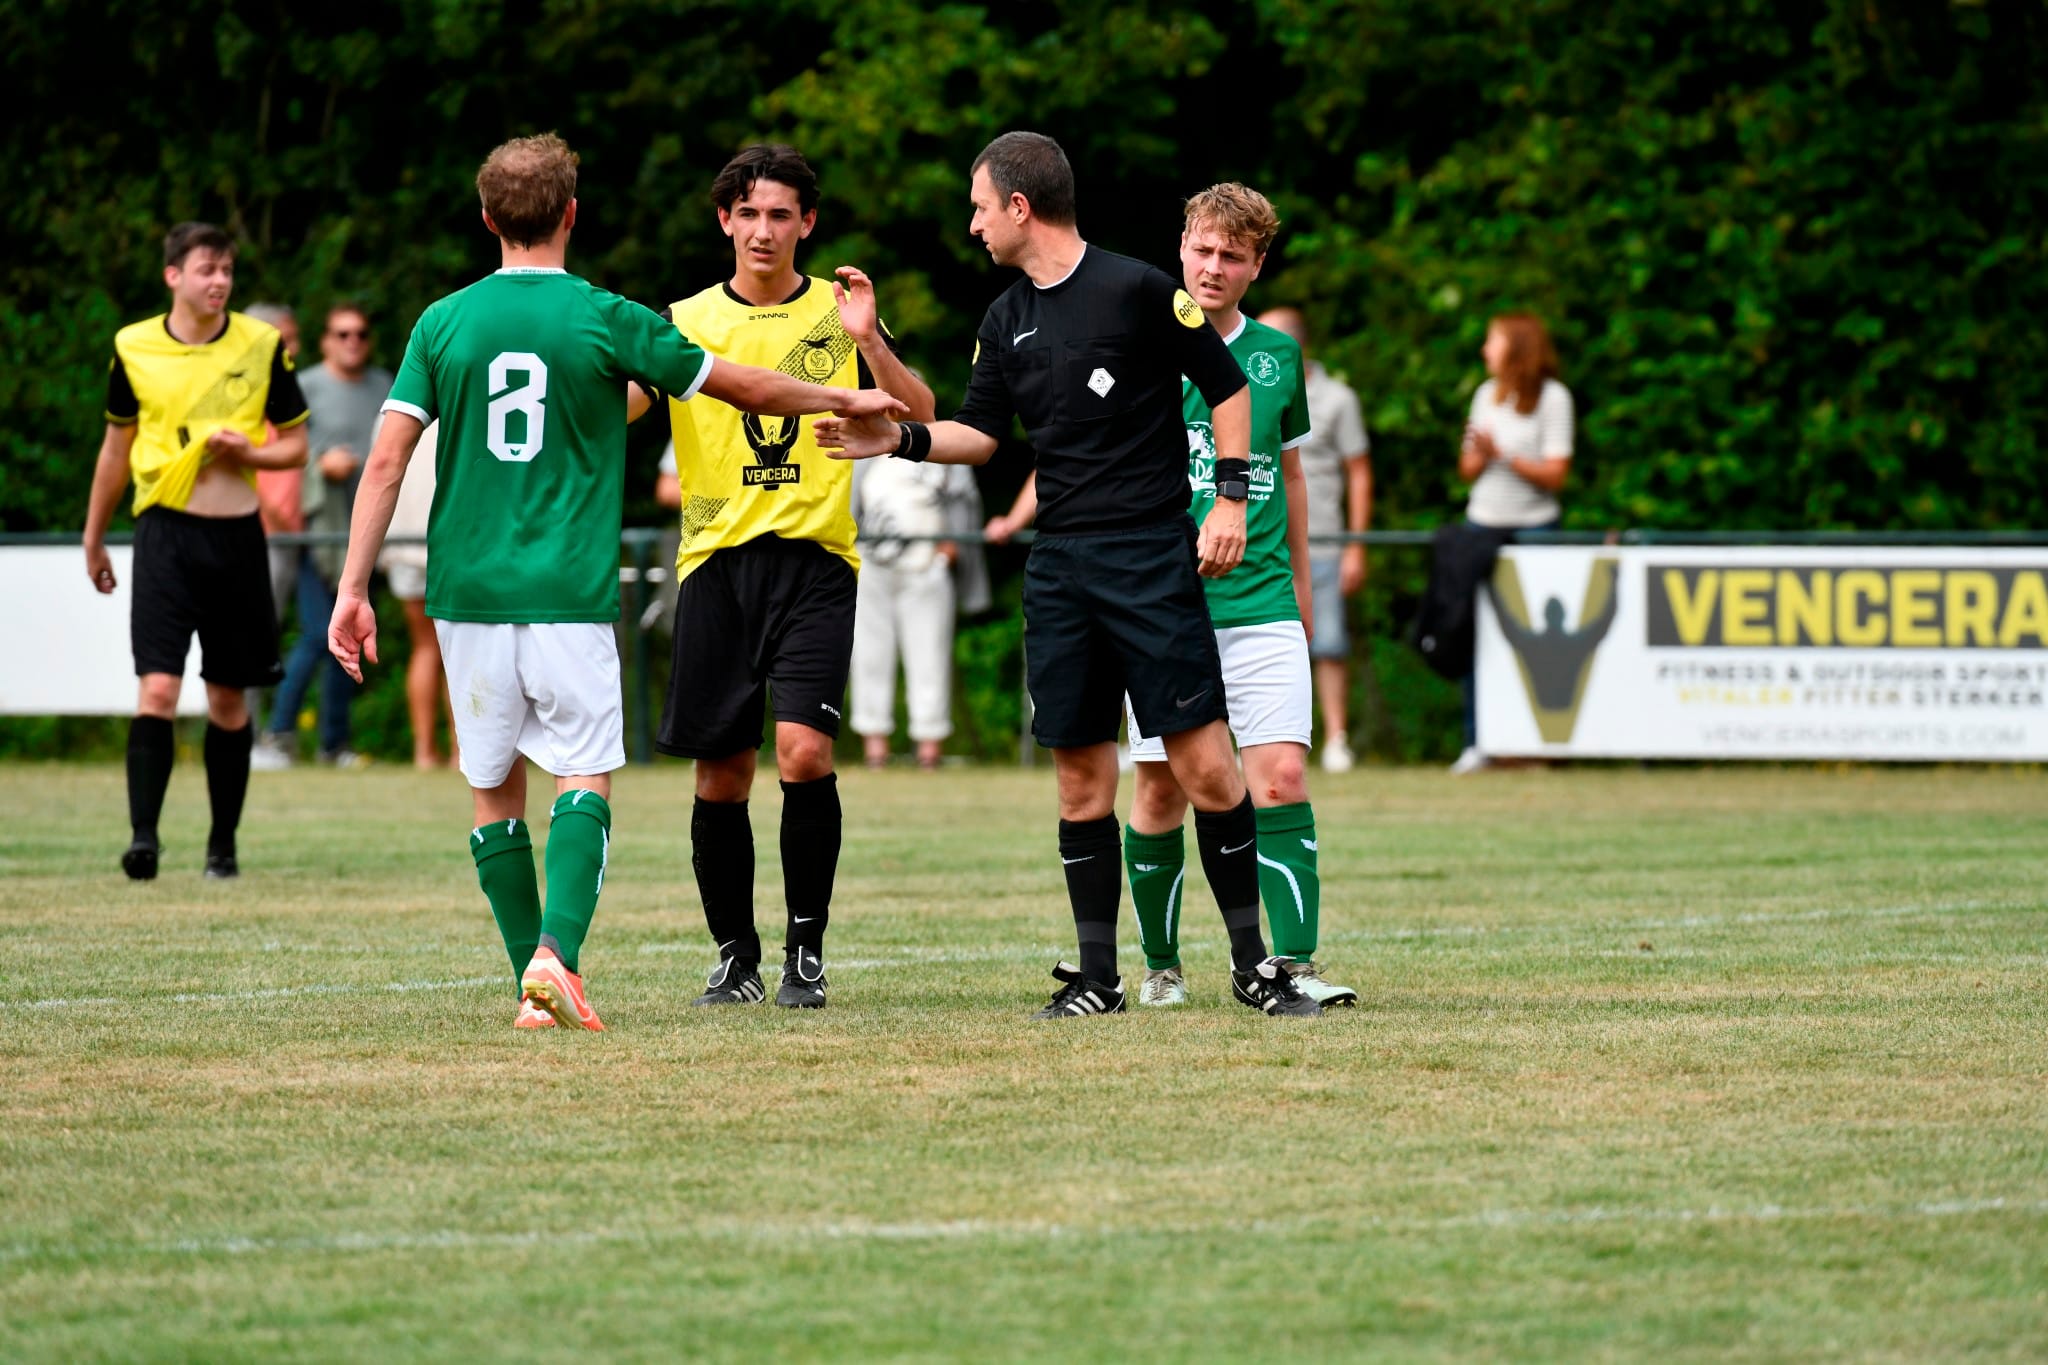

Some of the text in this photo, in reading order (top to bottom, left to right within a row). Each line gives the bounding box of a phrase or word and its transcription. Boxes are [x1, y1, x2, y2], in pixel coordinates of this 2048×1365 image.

[748, 312, 789, 321] STANNO
[487, 352, 548, 462] 8
[745, 466, 797, 483] VENCERA
[1662, 568, 2048, 648] VENCERA
[1657, 662, 1775, 682] FITNESS
